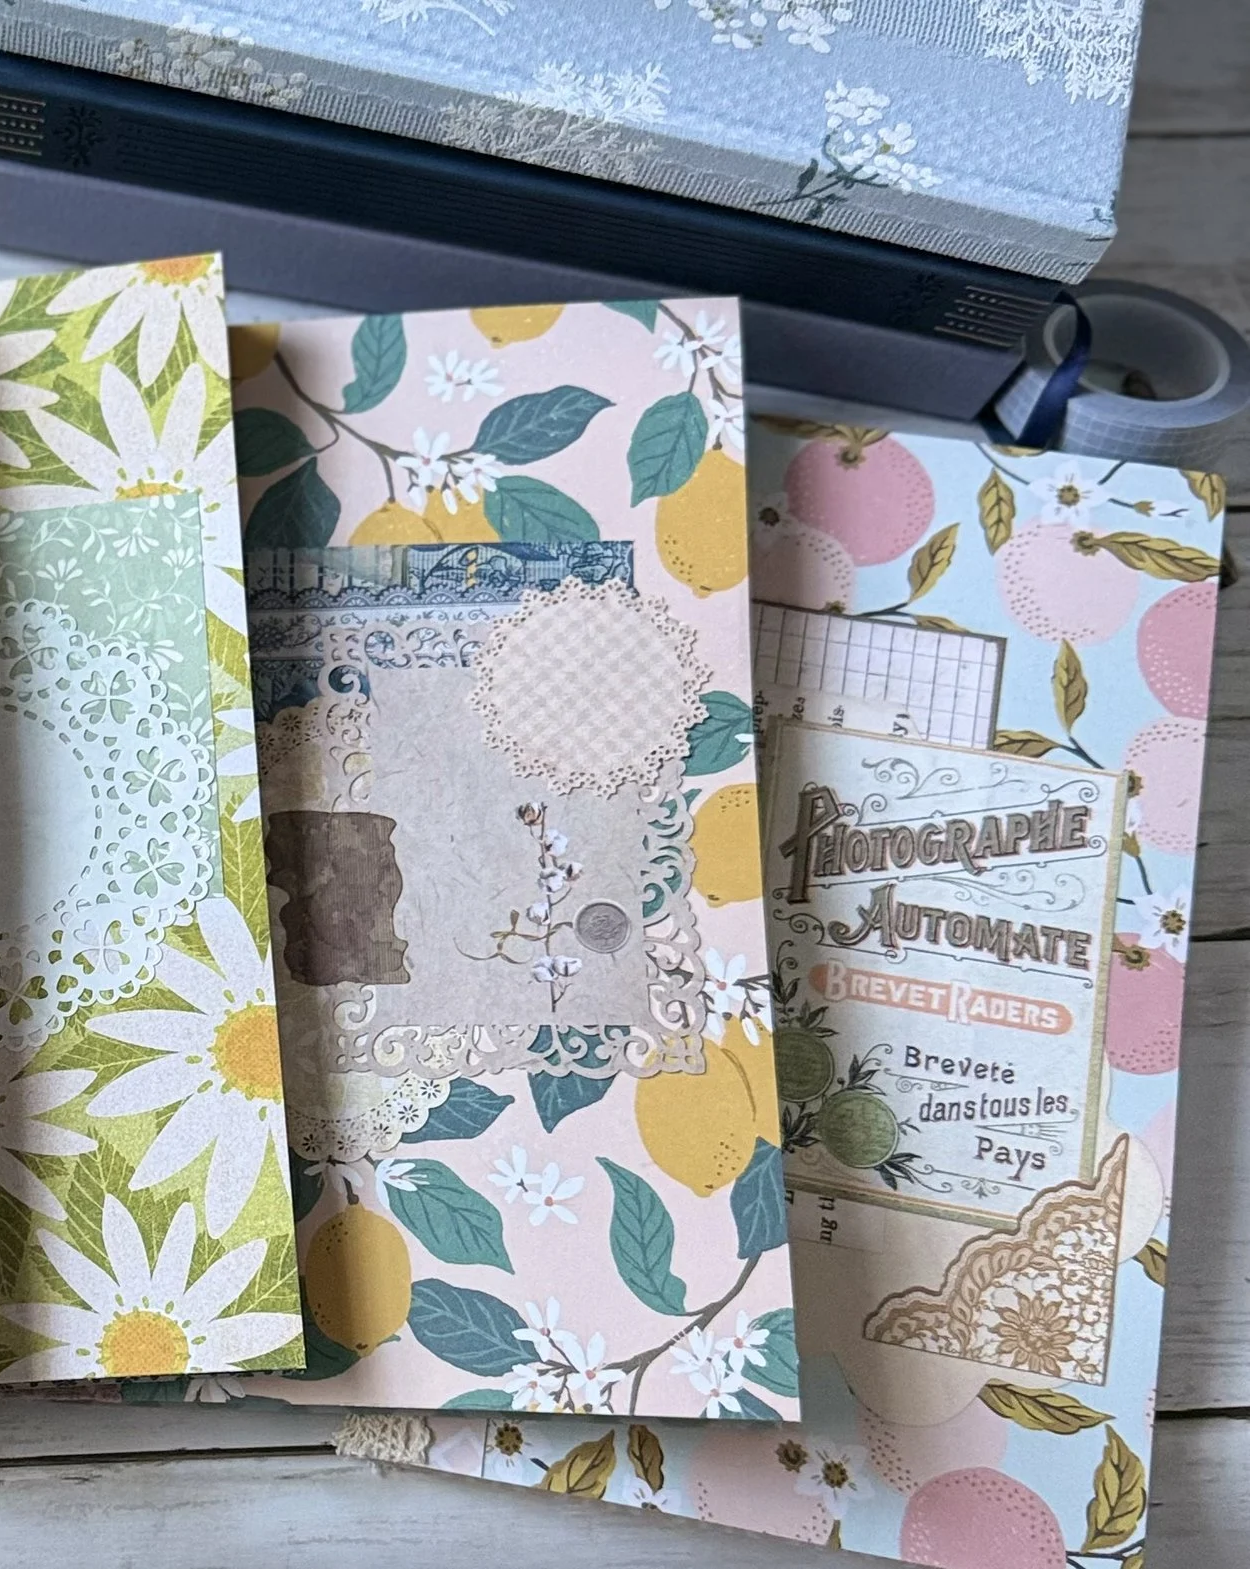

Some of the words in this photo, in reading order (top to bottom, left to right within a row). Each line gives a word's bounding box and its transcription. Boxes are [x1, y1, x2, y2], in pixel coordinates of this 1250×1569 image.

[779, 785, 1093, 905] PHOTOGRAPHE
[828, 881, 1093, 970] AUTOMATE
[973, 1135, 1047, 1182] Pays
